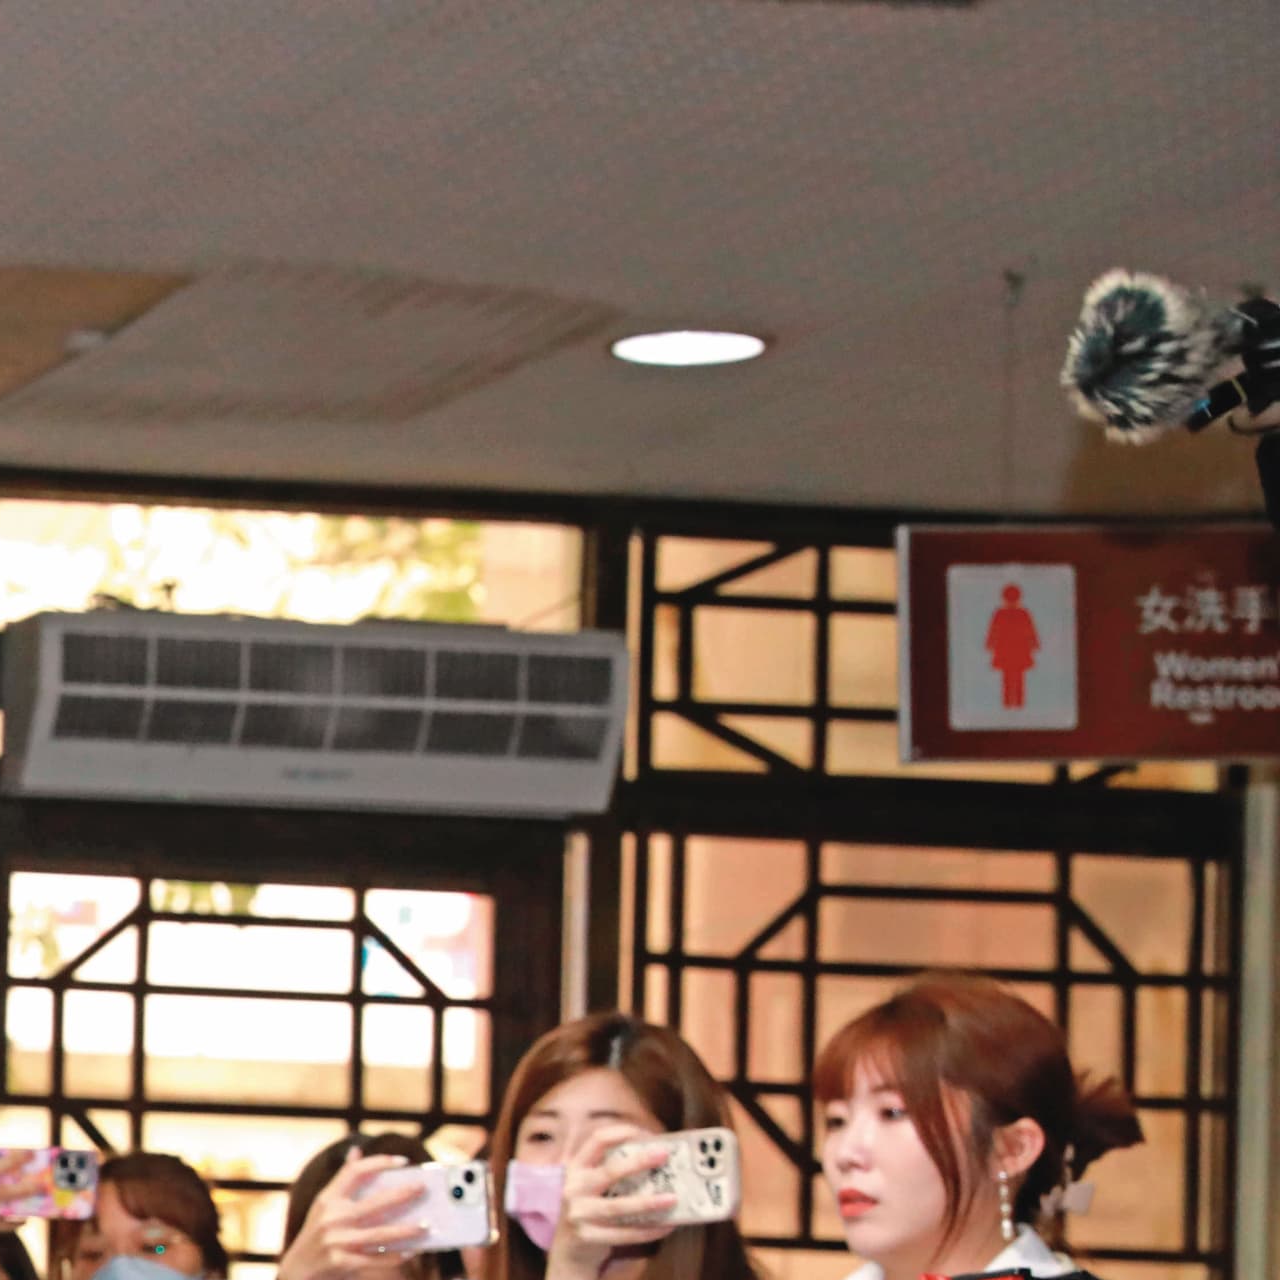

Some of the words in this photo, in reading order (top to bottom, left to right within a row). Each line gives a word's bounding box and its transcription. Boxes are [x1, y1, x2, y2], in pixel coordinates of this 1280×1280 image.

[1137, 585, 1280, 634] 女洗手
[1154, 651, 1280, 681] Women
